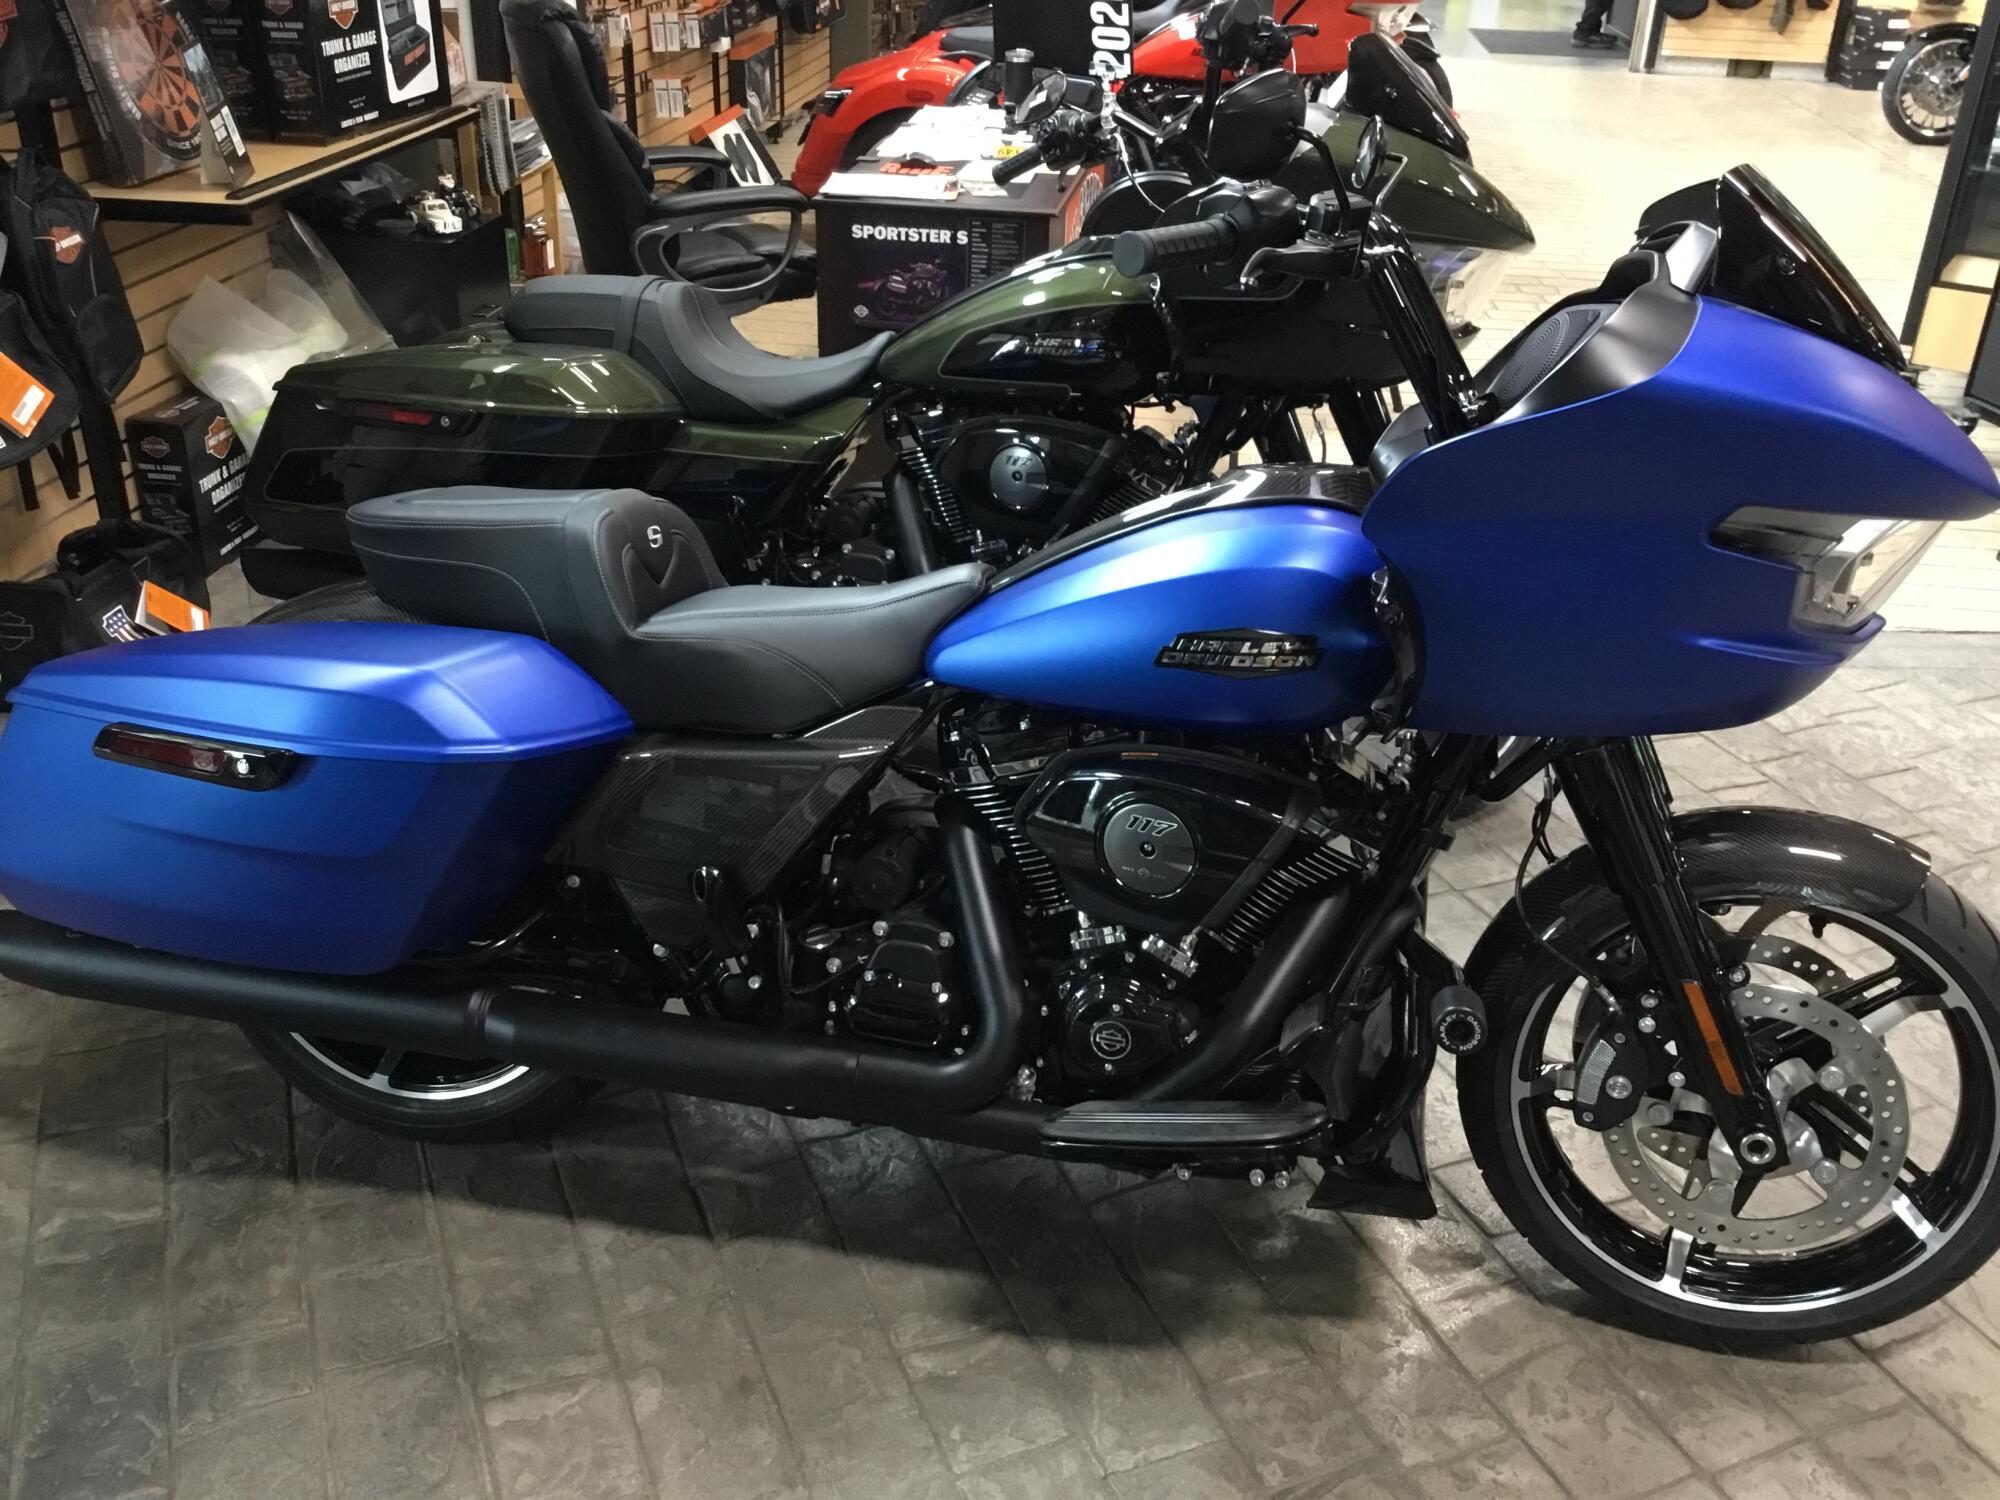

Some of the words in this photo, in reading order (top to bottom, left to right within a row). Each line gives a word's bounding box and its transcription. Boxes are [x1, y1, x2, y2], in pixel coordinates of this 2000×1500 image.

[321, 38, 345, 57] TRUNK
[345, 37, 352, 51] &
[352, 30, 377, 50] GARAGE
[1090, 0, 1131, 77] 202
[334, 51, 371, 74] ORGANIZER
[851, 224, 952, 244] SPORTSTER
[956, 230, 969, 245] S
[199, 467, 222, 493] TRUNK
[222, 465, 229, 479] &
[1161, 652, 1317, 667] DAVIDSON
[1125, 814, 1178, 837] 117
